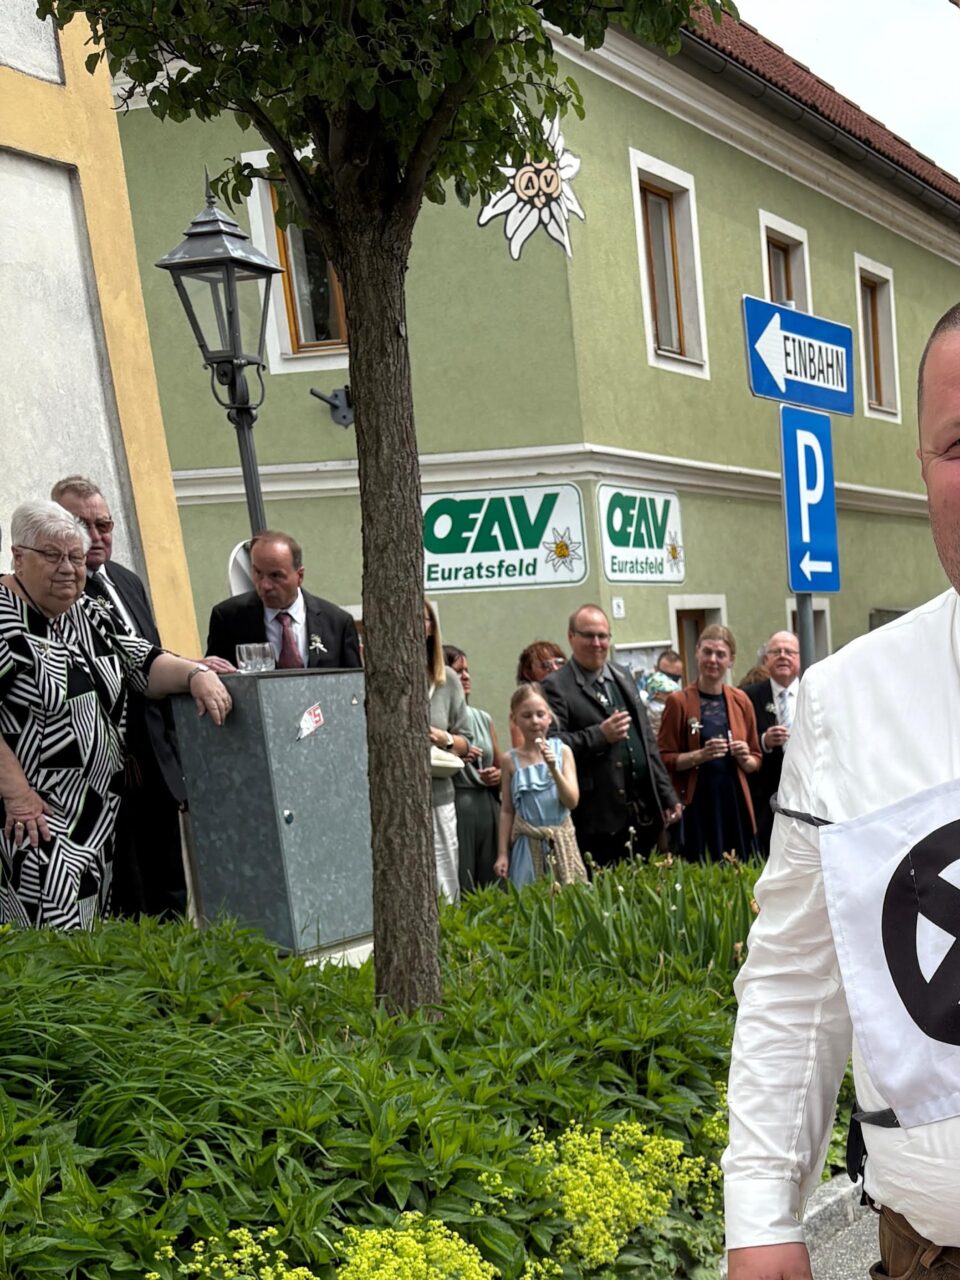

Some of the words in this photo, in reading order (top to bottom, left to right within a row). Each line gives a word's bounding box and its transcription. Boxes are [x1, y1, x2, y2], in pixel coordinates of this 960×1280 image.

[783, 334, 845, 389] EINBAHN
[796, 429, 825, 543] P
[426, 558, 538, 582] Euratsfeld
[610, 555, 664, 575] Euratsfeld
